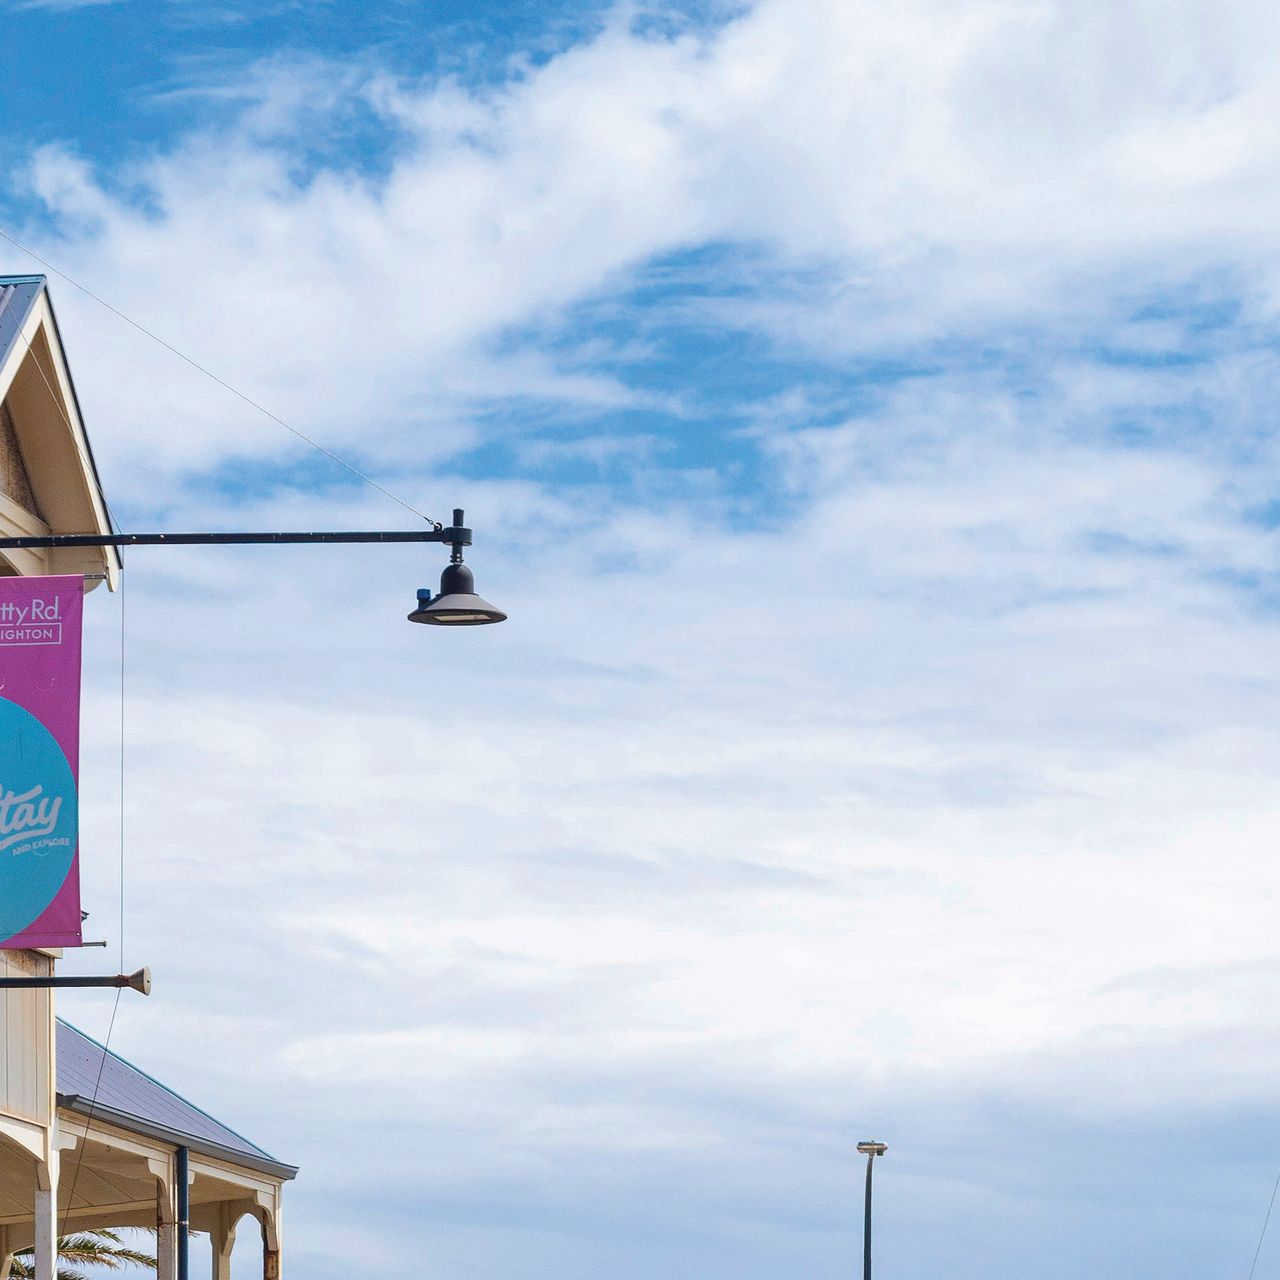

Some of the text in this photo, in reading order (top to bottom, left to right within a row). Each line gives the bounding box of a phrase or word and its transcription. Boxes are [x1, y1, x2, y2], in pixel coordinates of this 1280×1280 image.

[31, 595, 63, 620] Rd.
[12, 837, 70, 856] AND EXPLORE
